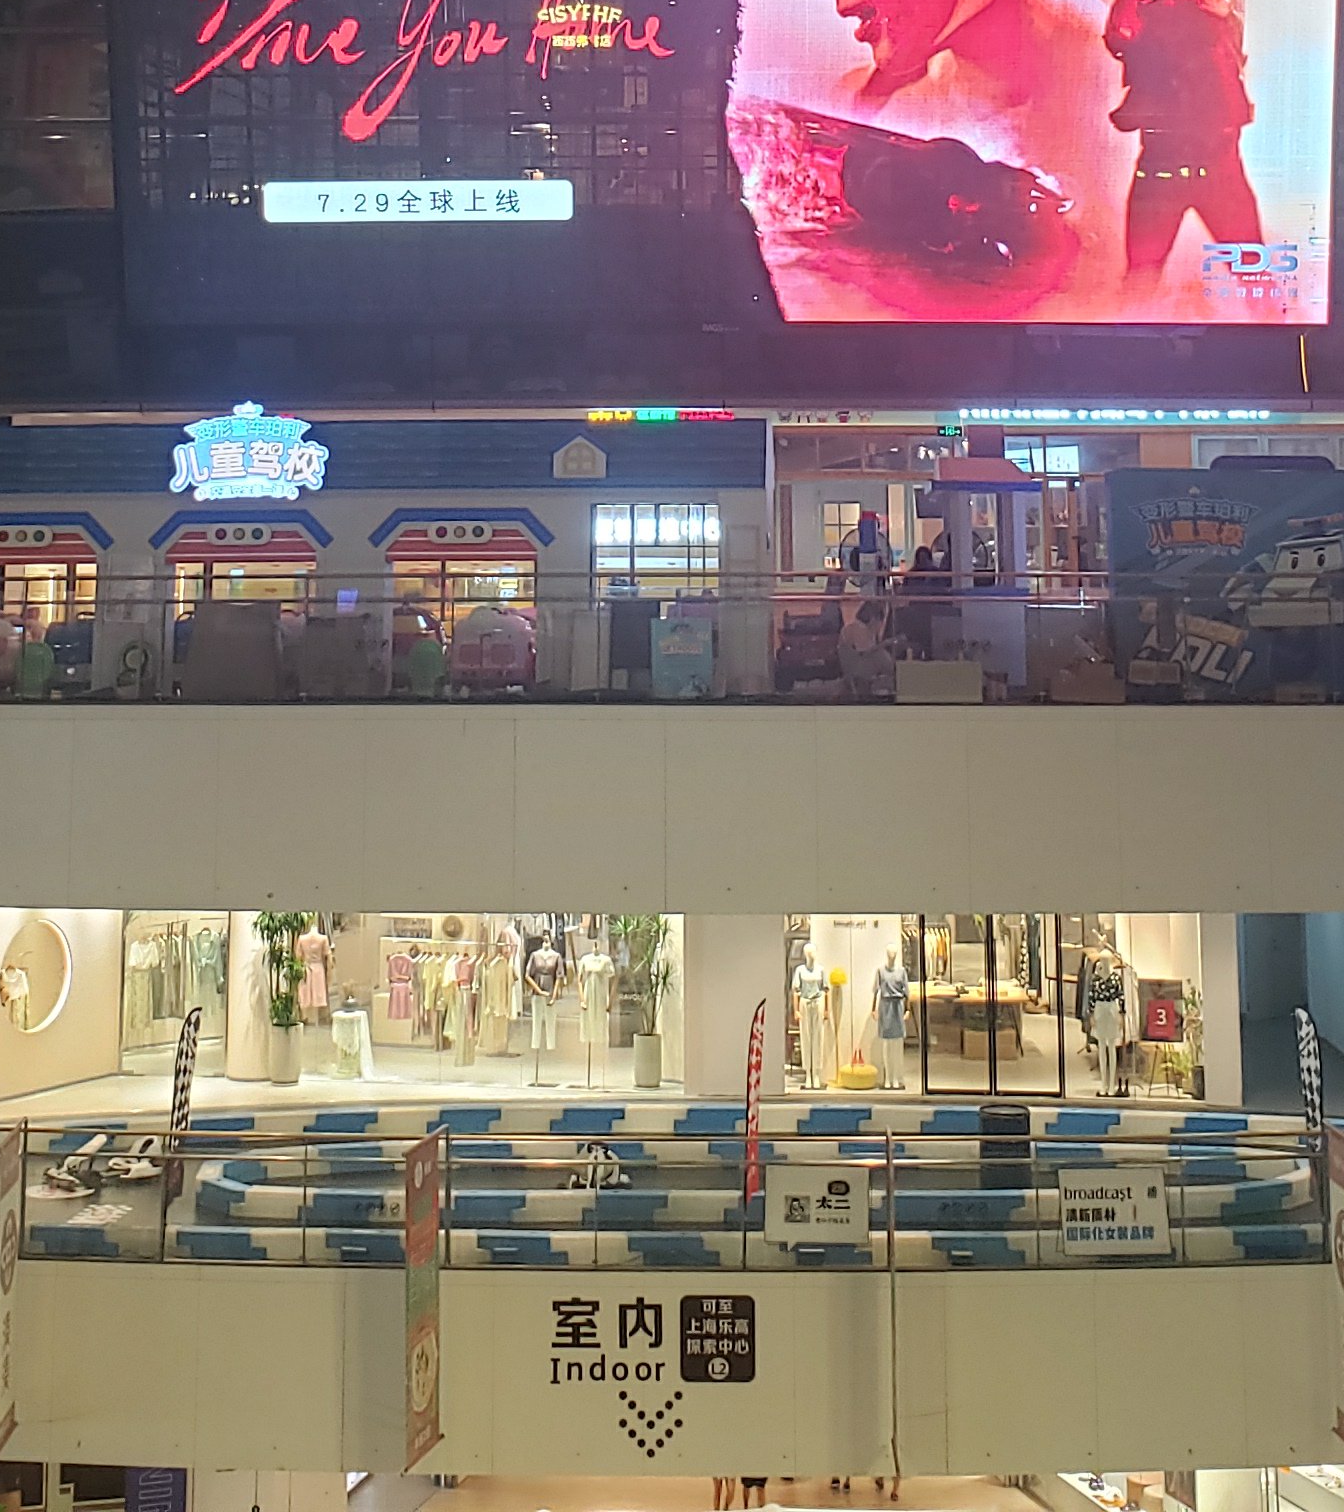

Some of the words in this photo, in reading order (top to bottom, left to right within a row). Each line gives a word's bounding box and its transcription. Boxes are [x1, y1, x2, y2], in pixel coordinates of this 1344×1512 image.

[317, 190, 522, 215] 7.29全球上线
[197, 418, 300, 439] 变形警车珀利
[174, 441, 324, 486] 儿童驾校
[1155, 1008, 1167, 1025] 3
[816, 1195, 851, 1209] 太二
[1064, 1186, 1133, 1202] broadcast
[702, 1299, 733, 1315] 可至
[551, 1296, 662, 1349] 室内
[686, 1318, 749, 1334] 上海乐高
[686, 1338, 749, 1355] 探索中心
[550, 1353, 665, 1384] Indoor
[711, 1362, 727, 1375] L2
